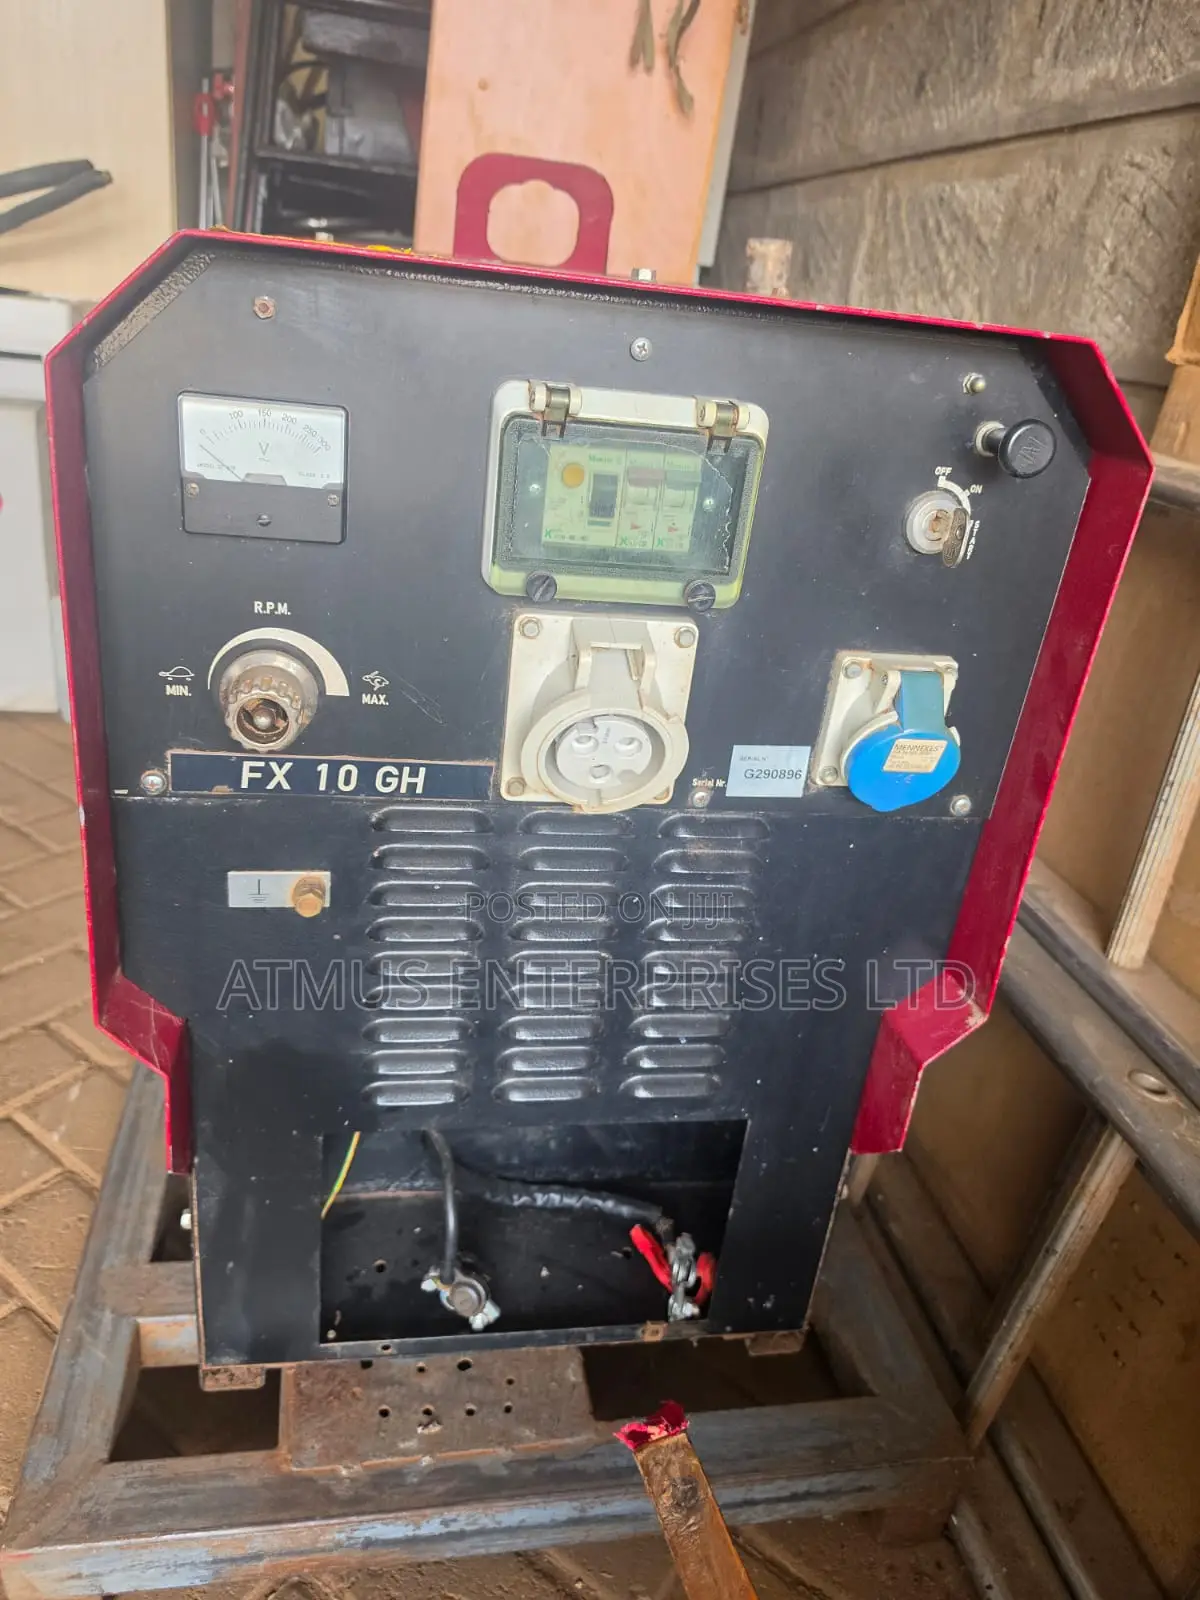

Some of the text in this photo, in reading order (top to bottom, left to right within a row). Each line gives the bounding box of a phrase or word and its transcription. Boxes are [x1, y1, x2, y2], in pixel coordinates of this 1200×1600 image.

[228, 410, 244, 420] 100
[258, 408, 272, 418] 150
[281, 412, 297, 424] 200
[302, 424, 318, 437] 250
[259, 442, 270, 456] V
[935, 466, 952, 476] OFF
[970, 484, 983, 494] ON
[253, 600, 291, 616] R.P.M.
[165, 684, 192, 697] MIN.
[361, 693, 389, 706] MAX.
[240, 761, 426, 794] FX 10 GH
[743, 768, 802, 780] G290896
[692, 778, 714, 787] Serial
